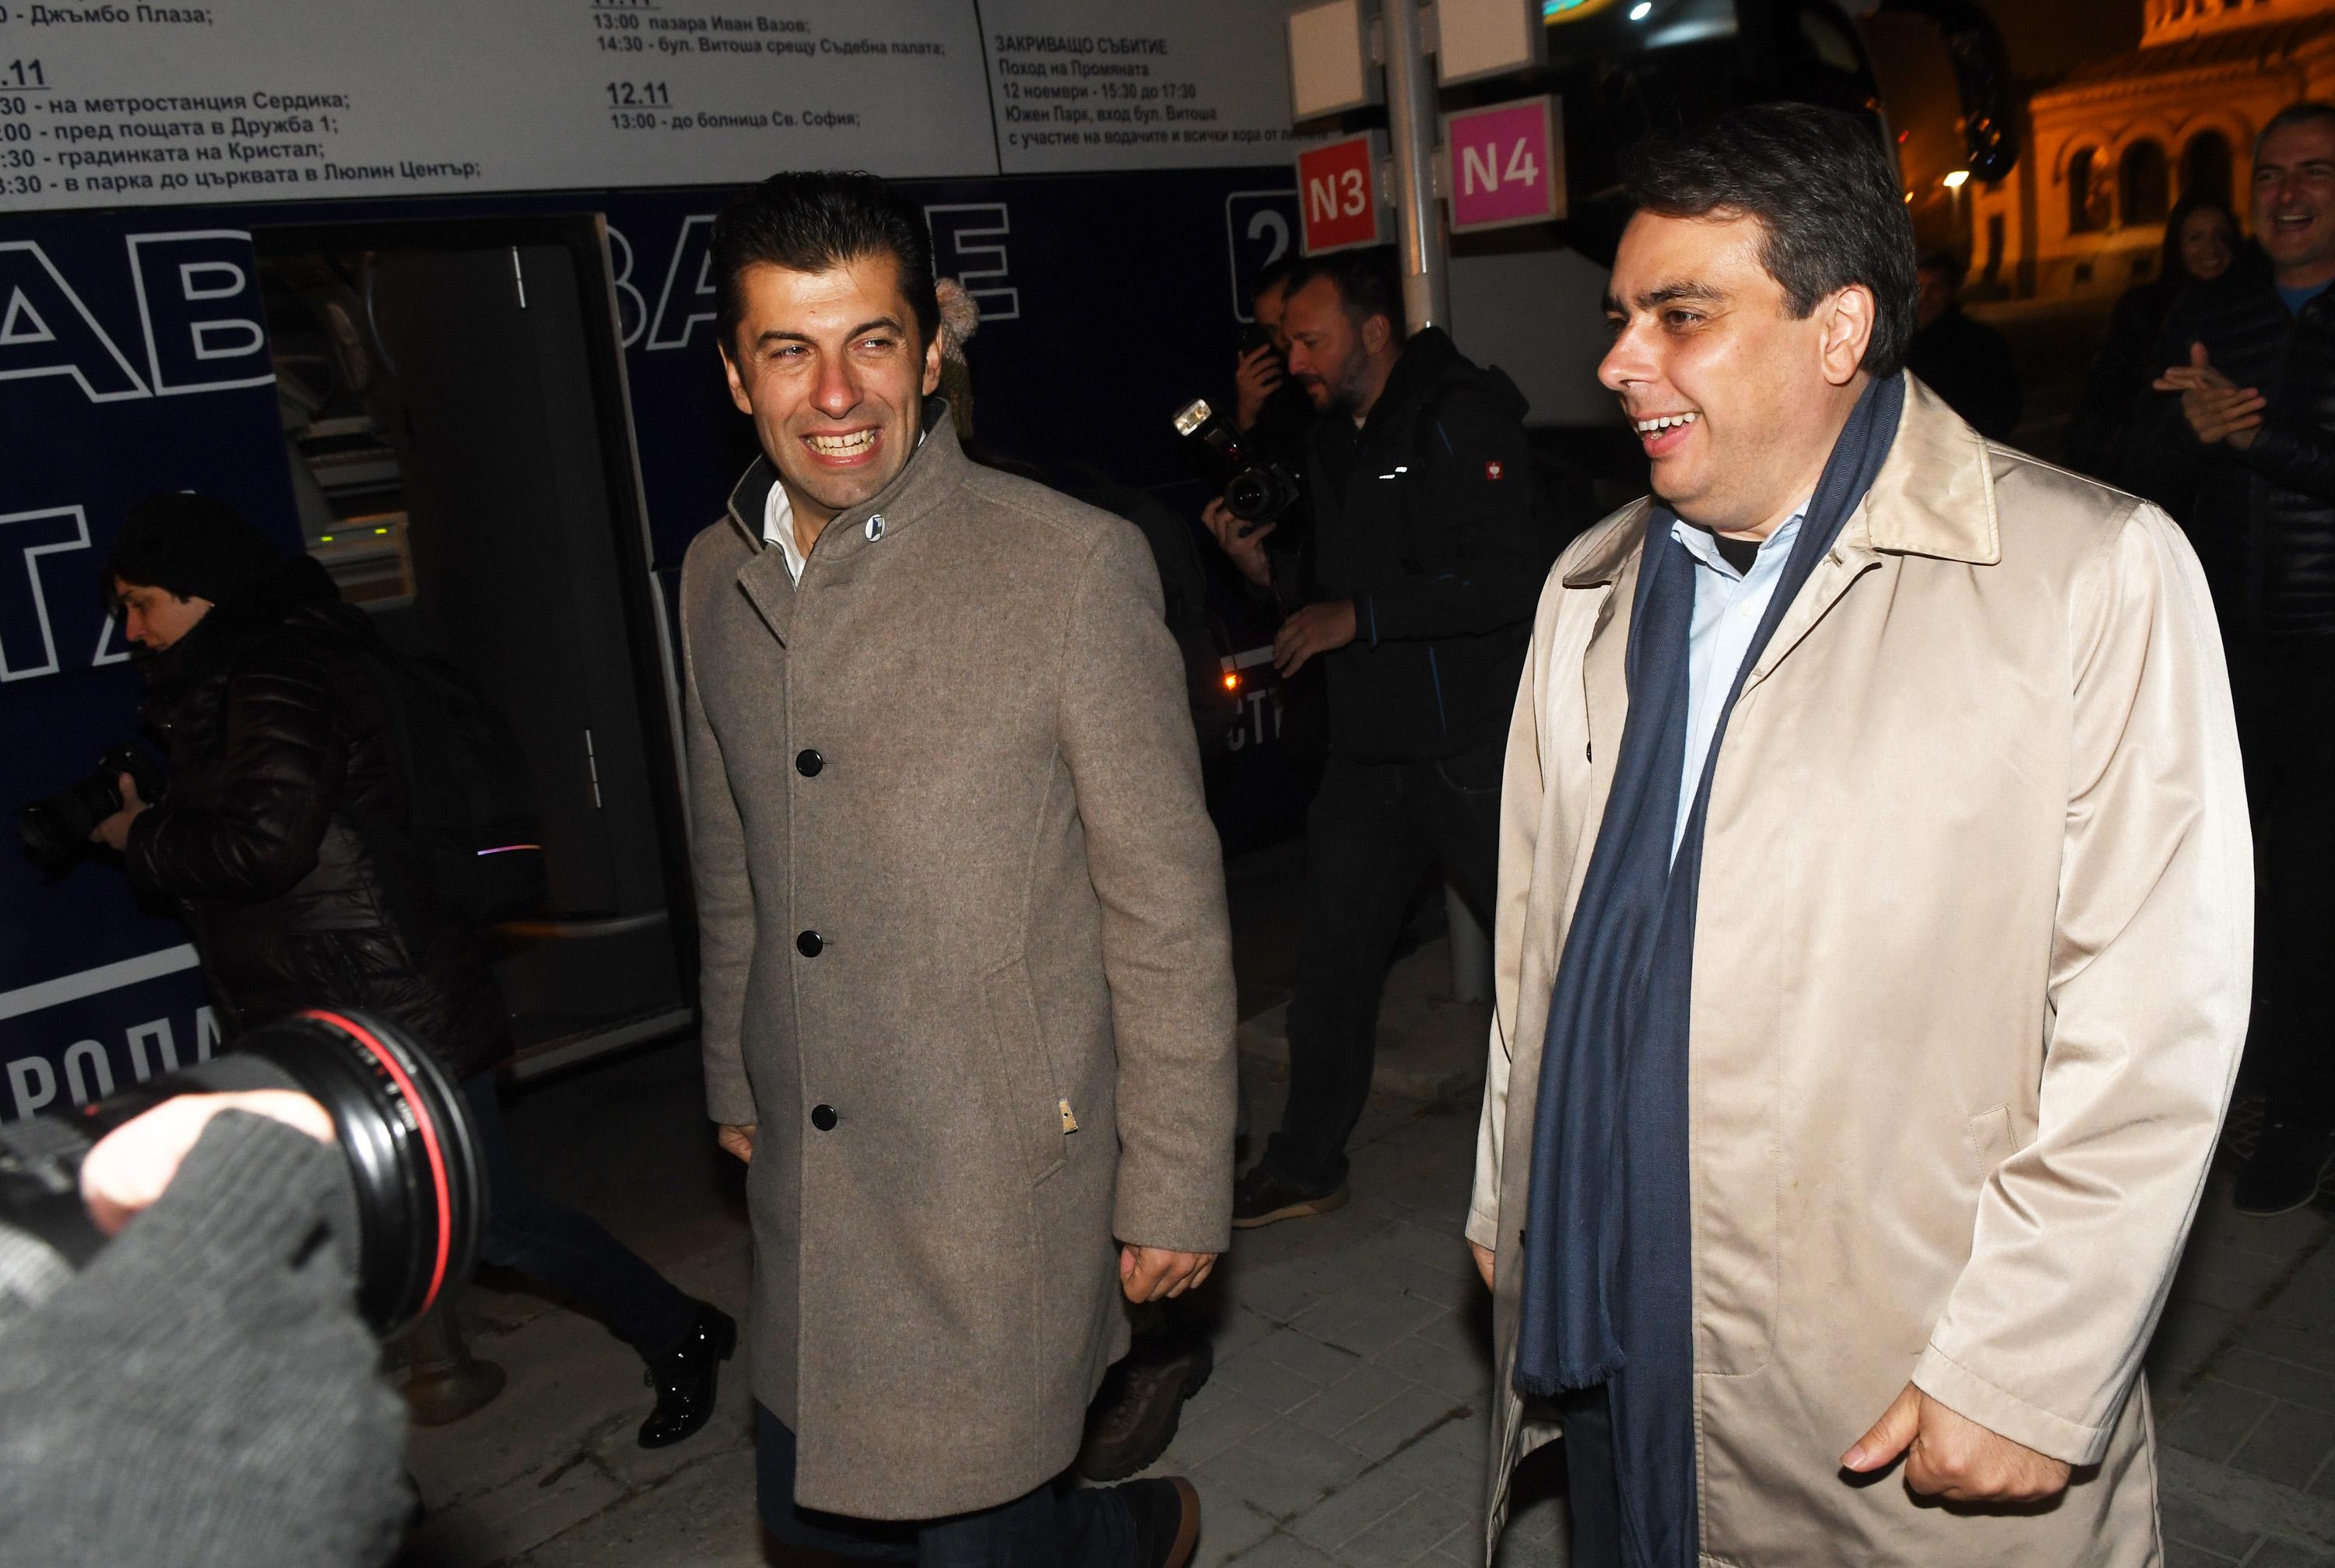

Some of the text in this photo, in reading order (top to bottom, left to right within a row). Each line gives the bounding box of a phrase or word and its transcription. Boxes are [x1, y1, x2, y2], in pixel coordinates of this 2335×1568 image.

[31, 5, 129, 26] Джъмбо
[136, 5, 212, 25] Плаза;
[594, 13, 810, 34] 13:00 пазара Иван Вазов;
[597, 36, 642, 51] 14:30
[658, 36, 694, 55] бул.
[698, 37, 761, 53] Витоша
[766, 40, 816, 57] срещу
[820, 39, 887, 55] Съдебна
[891, 42, 946, 58] палата;
[996, 36, 1168, 54] ЗАКРИВАЩО СЪБИТИЕ
[999, 58, 1149, 78] Поход на Промяната
[607, 82, 668, 104] 12.11
[1003, 82, 1019, 98] 12
[1024, 86, 1088, 101] ноември
[1102, 82, 1136, 99] 15:30
[1141, 87, 1158, 100] до
[1162, 83, 1196, 99] 17:30
[49, 99, 76, 113] на
[85, 96, 247, 115] метростанция
[253, 92, 350, 112] Сердика;
[611, 114, 655, 129] 13:00
[672, 116, 693, 129] до
[697, 113, 767, 128] болница
[772, 110, 798, 126] Св.
[802, 110, 859, 128] София;
[1006, 105, 1216, 124] Южен Парк, вход бул. Витоша
[54, 125, 113, 142] пред
[119, 123, 203, 140] пощата
[211, 122, 224, 135] в
[232, 117, 313, 137] Дружба
[320, 115, 338, 133] 1;
[1009, 133, 1017, 144] с
[1021, 132, 1079, 149] участие
[1083, 132, 1101, 144] на
[1105, 131, 1168, 146] водачите
[1173, 131, 1180, 141] и
[1184, 130, 1227, 142] всички
[1233, 129, 1260, 143] хора
[1265, 129, 1277, 140] от
[58, 148, 188, 169] градинката
[196, 146, 221, 160] на
[228, 142, 325, 162] Кристал;
[1462, 137, 1539, 195] N4
[65, 177, 79, 191] в
[86, 174, 153, 193] парка
[161, 174, 188, 190] до
[195, 168, 298, 188] църквата
[306, 168, 318, 181] в
[325, 164, 394, 181] Люлин
[400, 161, 481, 180] Център;
[1311, 168, 1366, 223] N3
